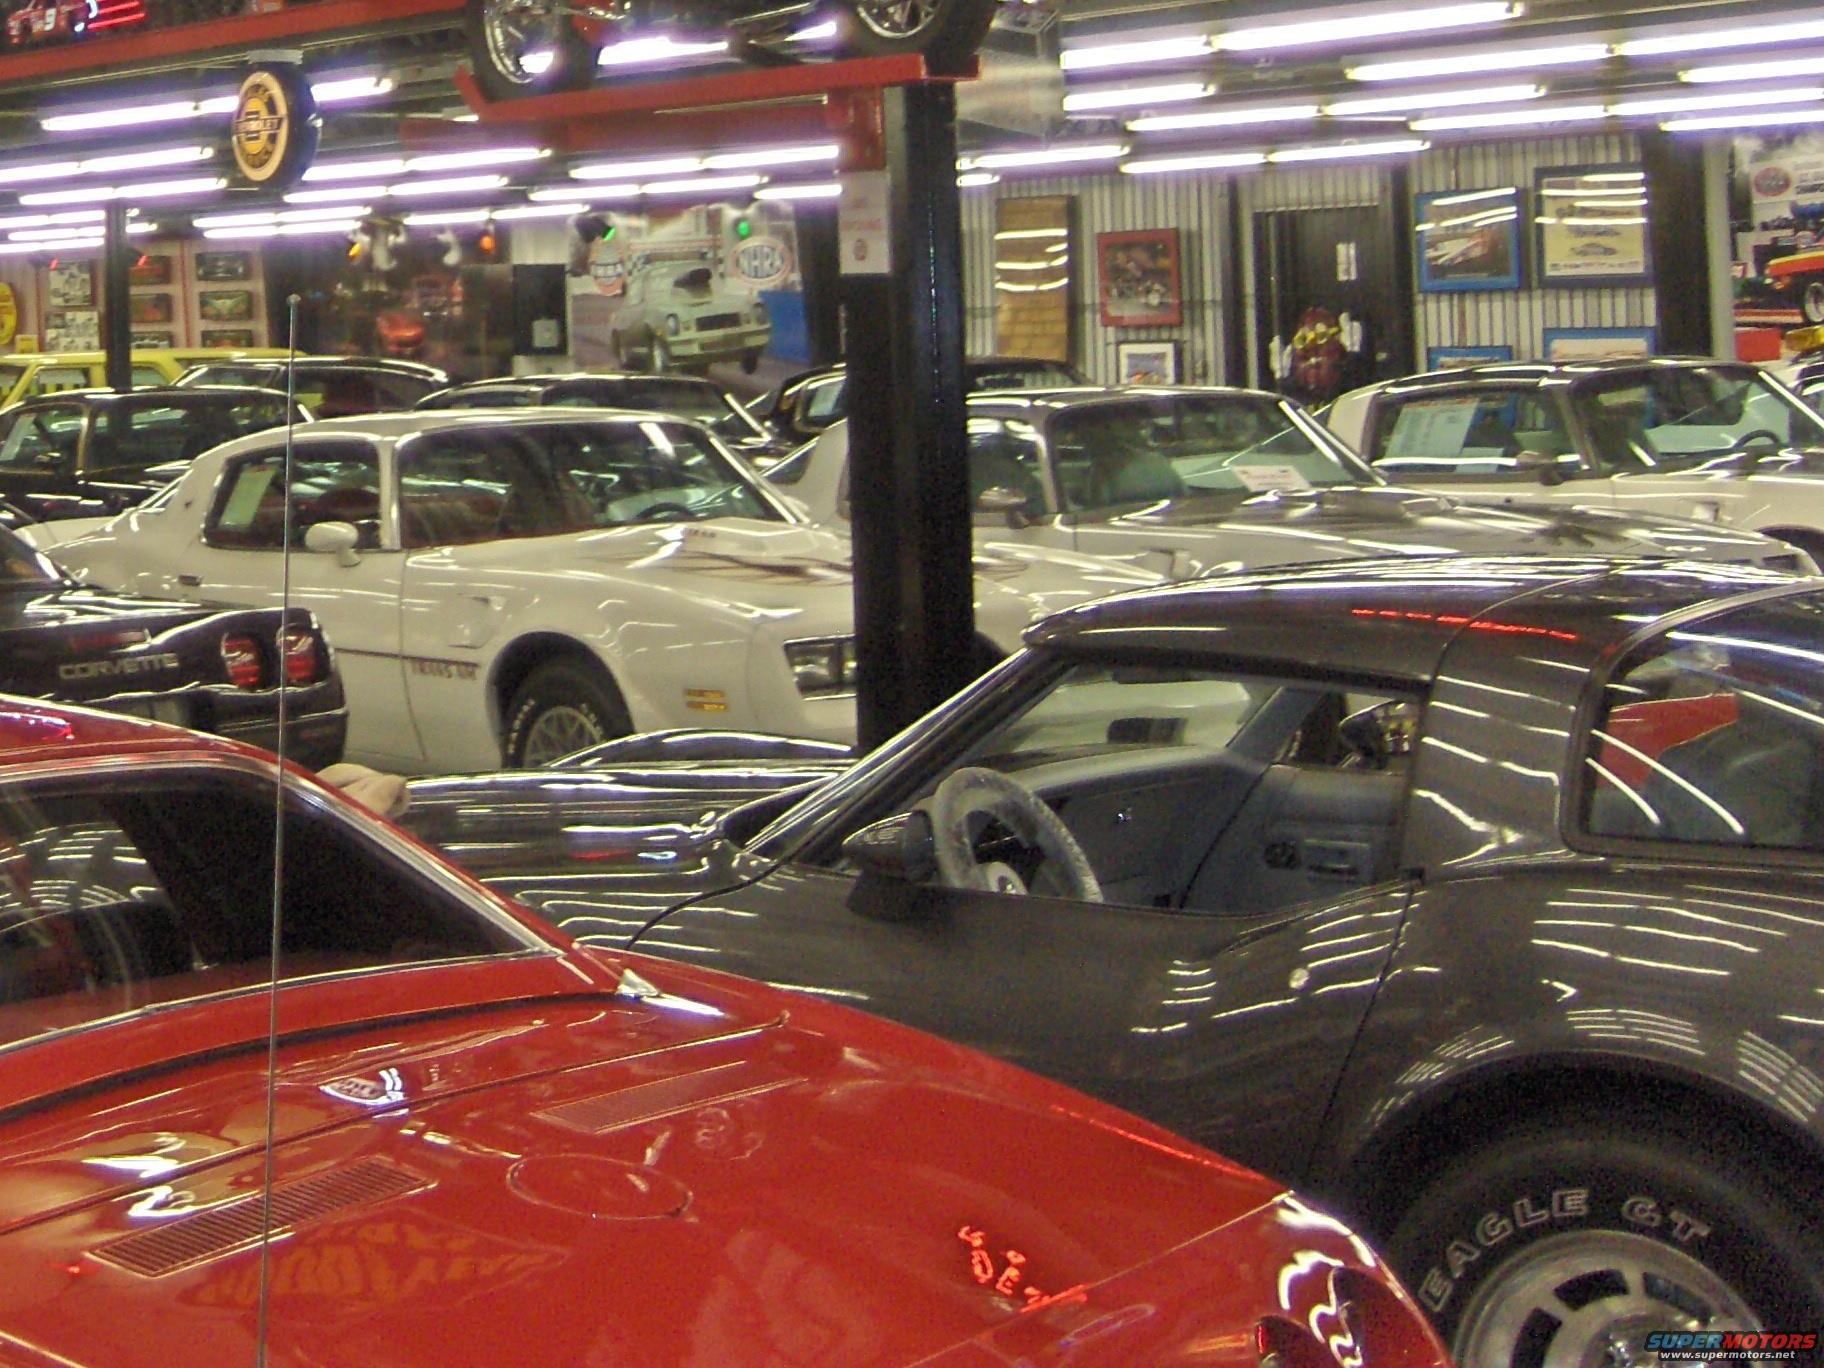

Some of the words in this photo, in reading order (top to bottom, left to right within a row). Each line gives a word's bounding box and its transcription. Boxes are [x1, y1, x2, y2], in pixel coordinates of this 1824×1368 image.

[58, 651, 180, 680] CORVETTE
[1417, 1187, 1590, 1314] EAGLE
[1620, 1194, 1714, 1244] GT
